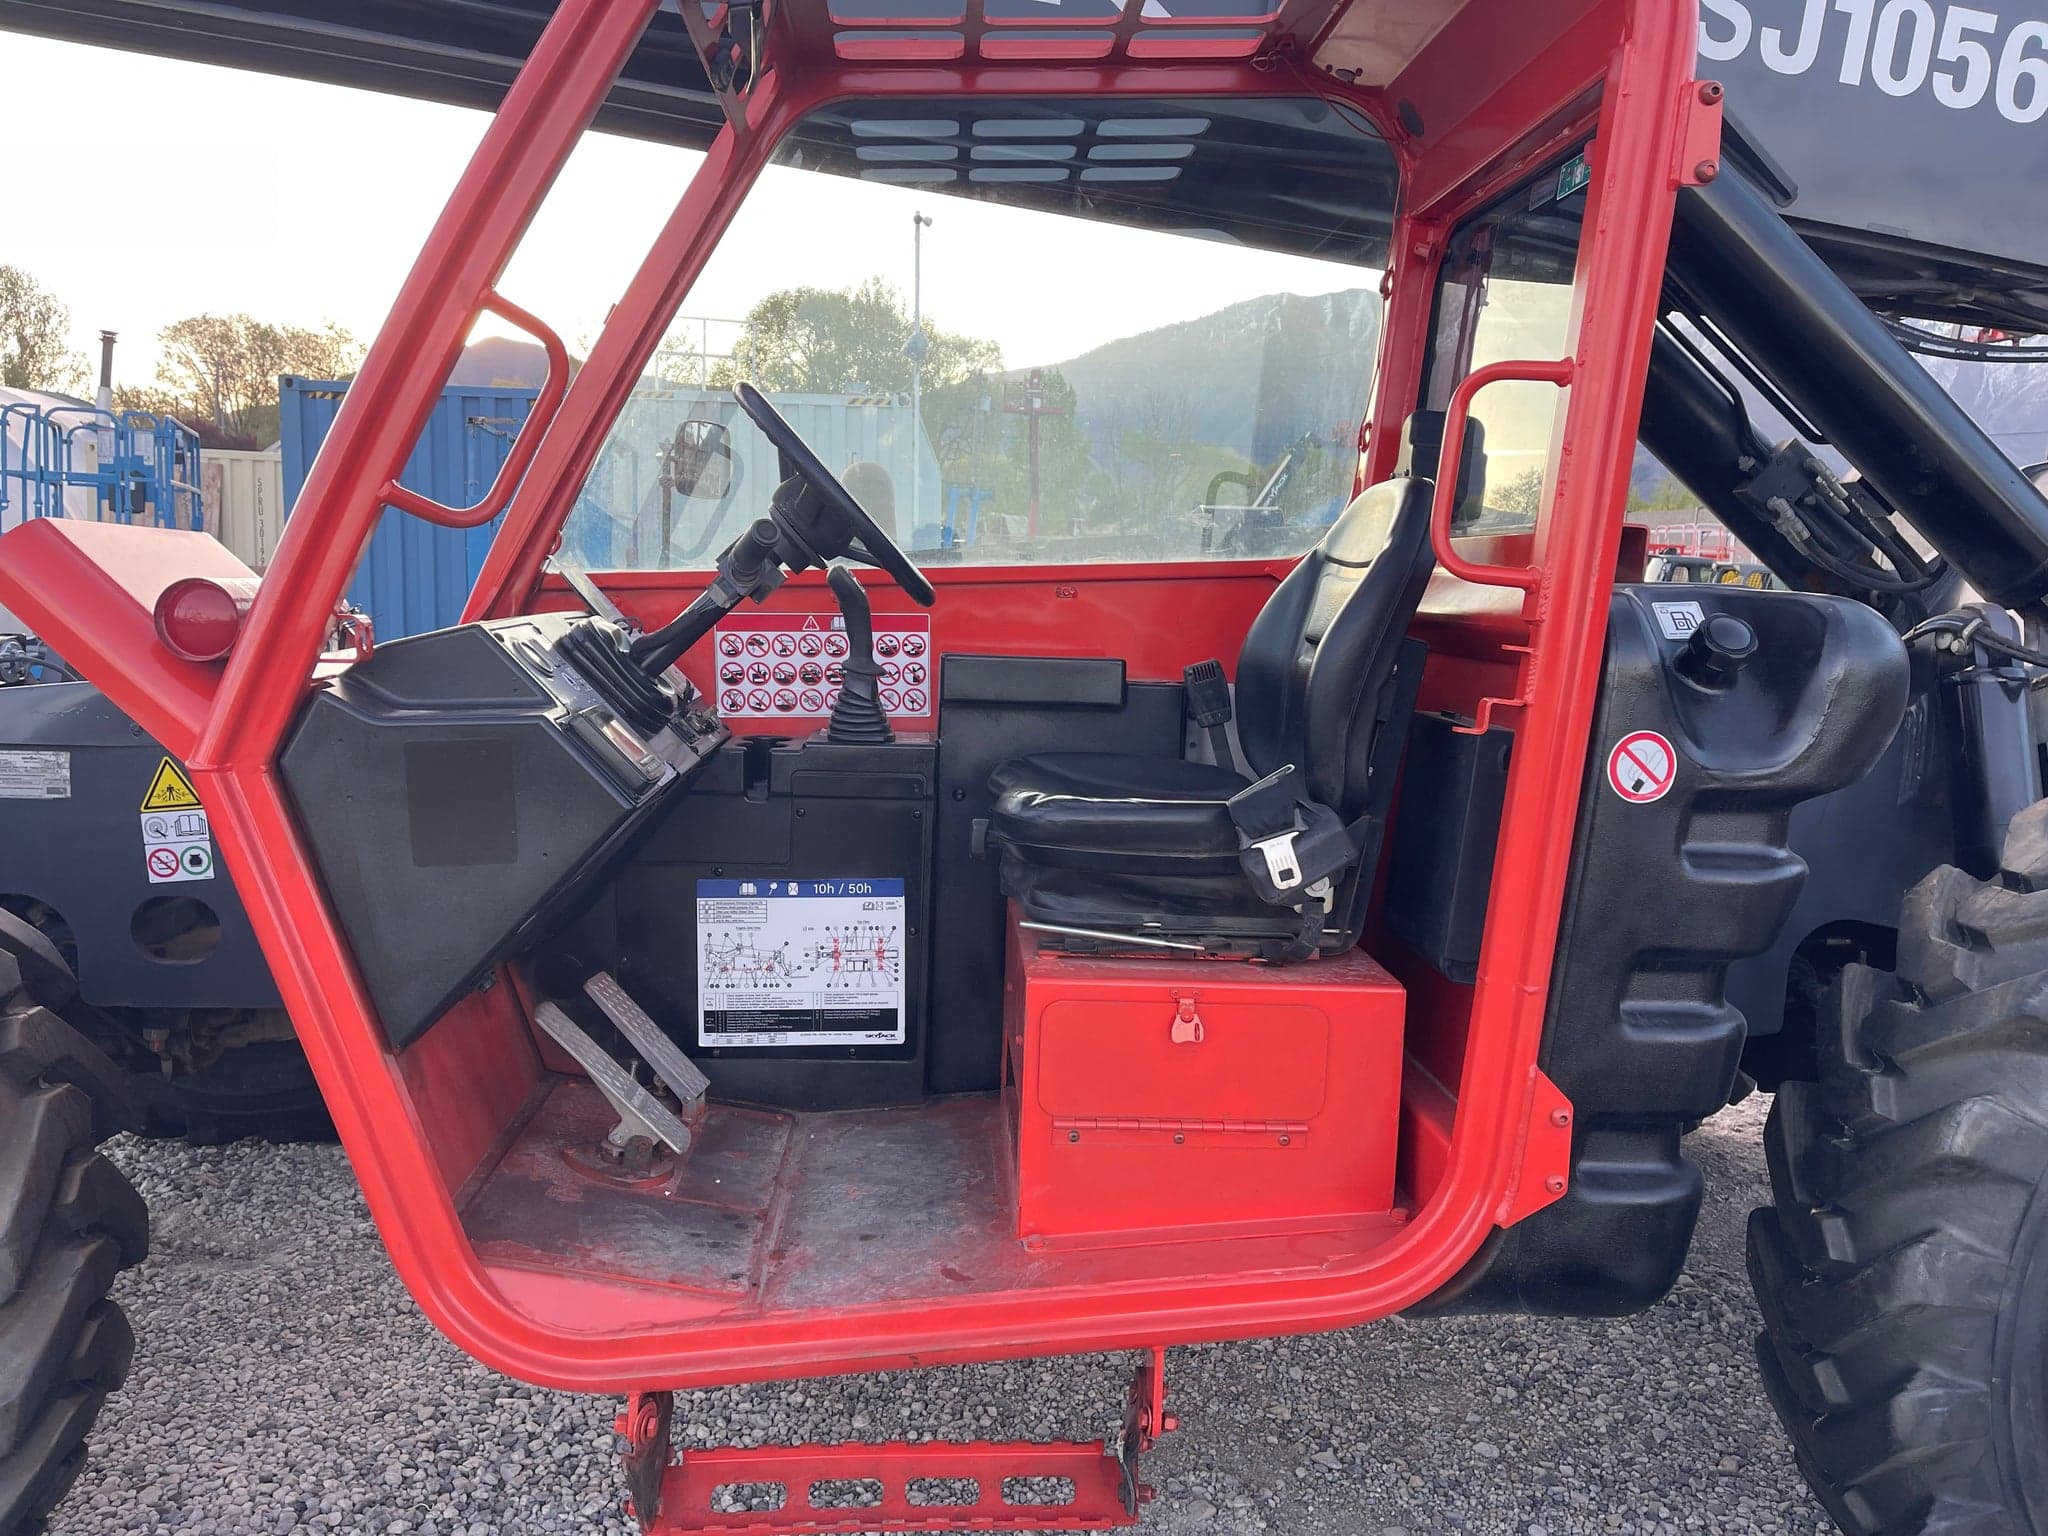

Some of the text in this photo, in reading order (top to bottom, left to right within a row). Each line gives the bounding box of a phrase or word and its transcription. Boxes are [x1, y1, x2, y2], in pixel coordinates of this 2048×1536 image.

[1698, 0, 2048, 123] SJ1056
[813, 882, 872, 895] 10h / 50h
